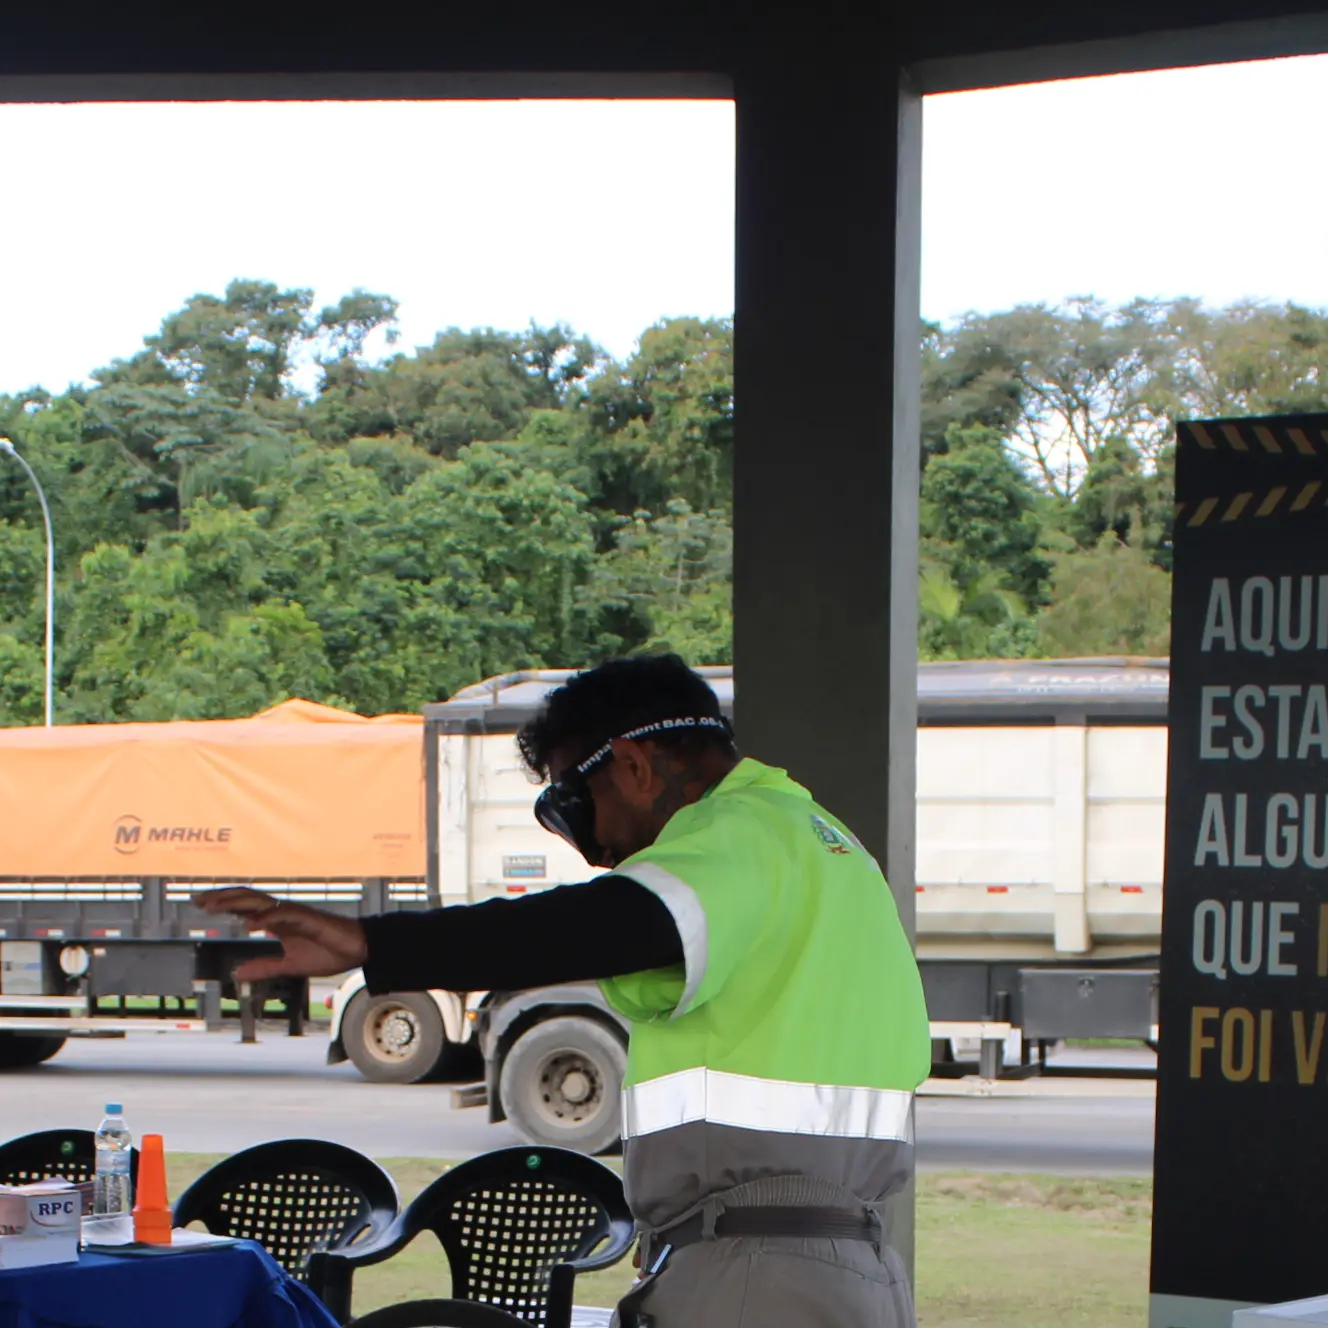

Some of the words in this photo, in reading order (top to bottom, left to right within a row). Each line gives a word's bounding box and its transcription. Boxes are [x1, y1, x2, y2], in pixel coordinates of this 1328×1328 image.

[662, 716, 696, 729] BAC
[148, 827, 232, 843] MAHLE
[1192, 898, 1300, 980] QUE
[1189, 1005, 1273, 1083] FOI
[38, 1201, 74, 1216] RPC
